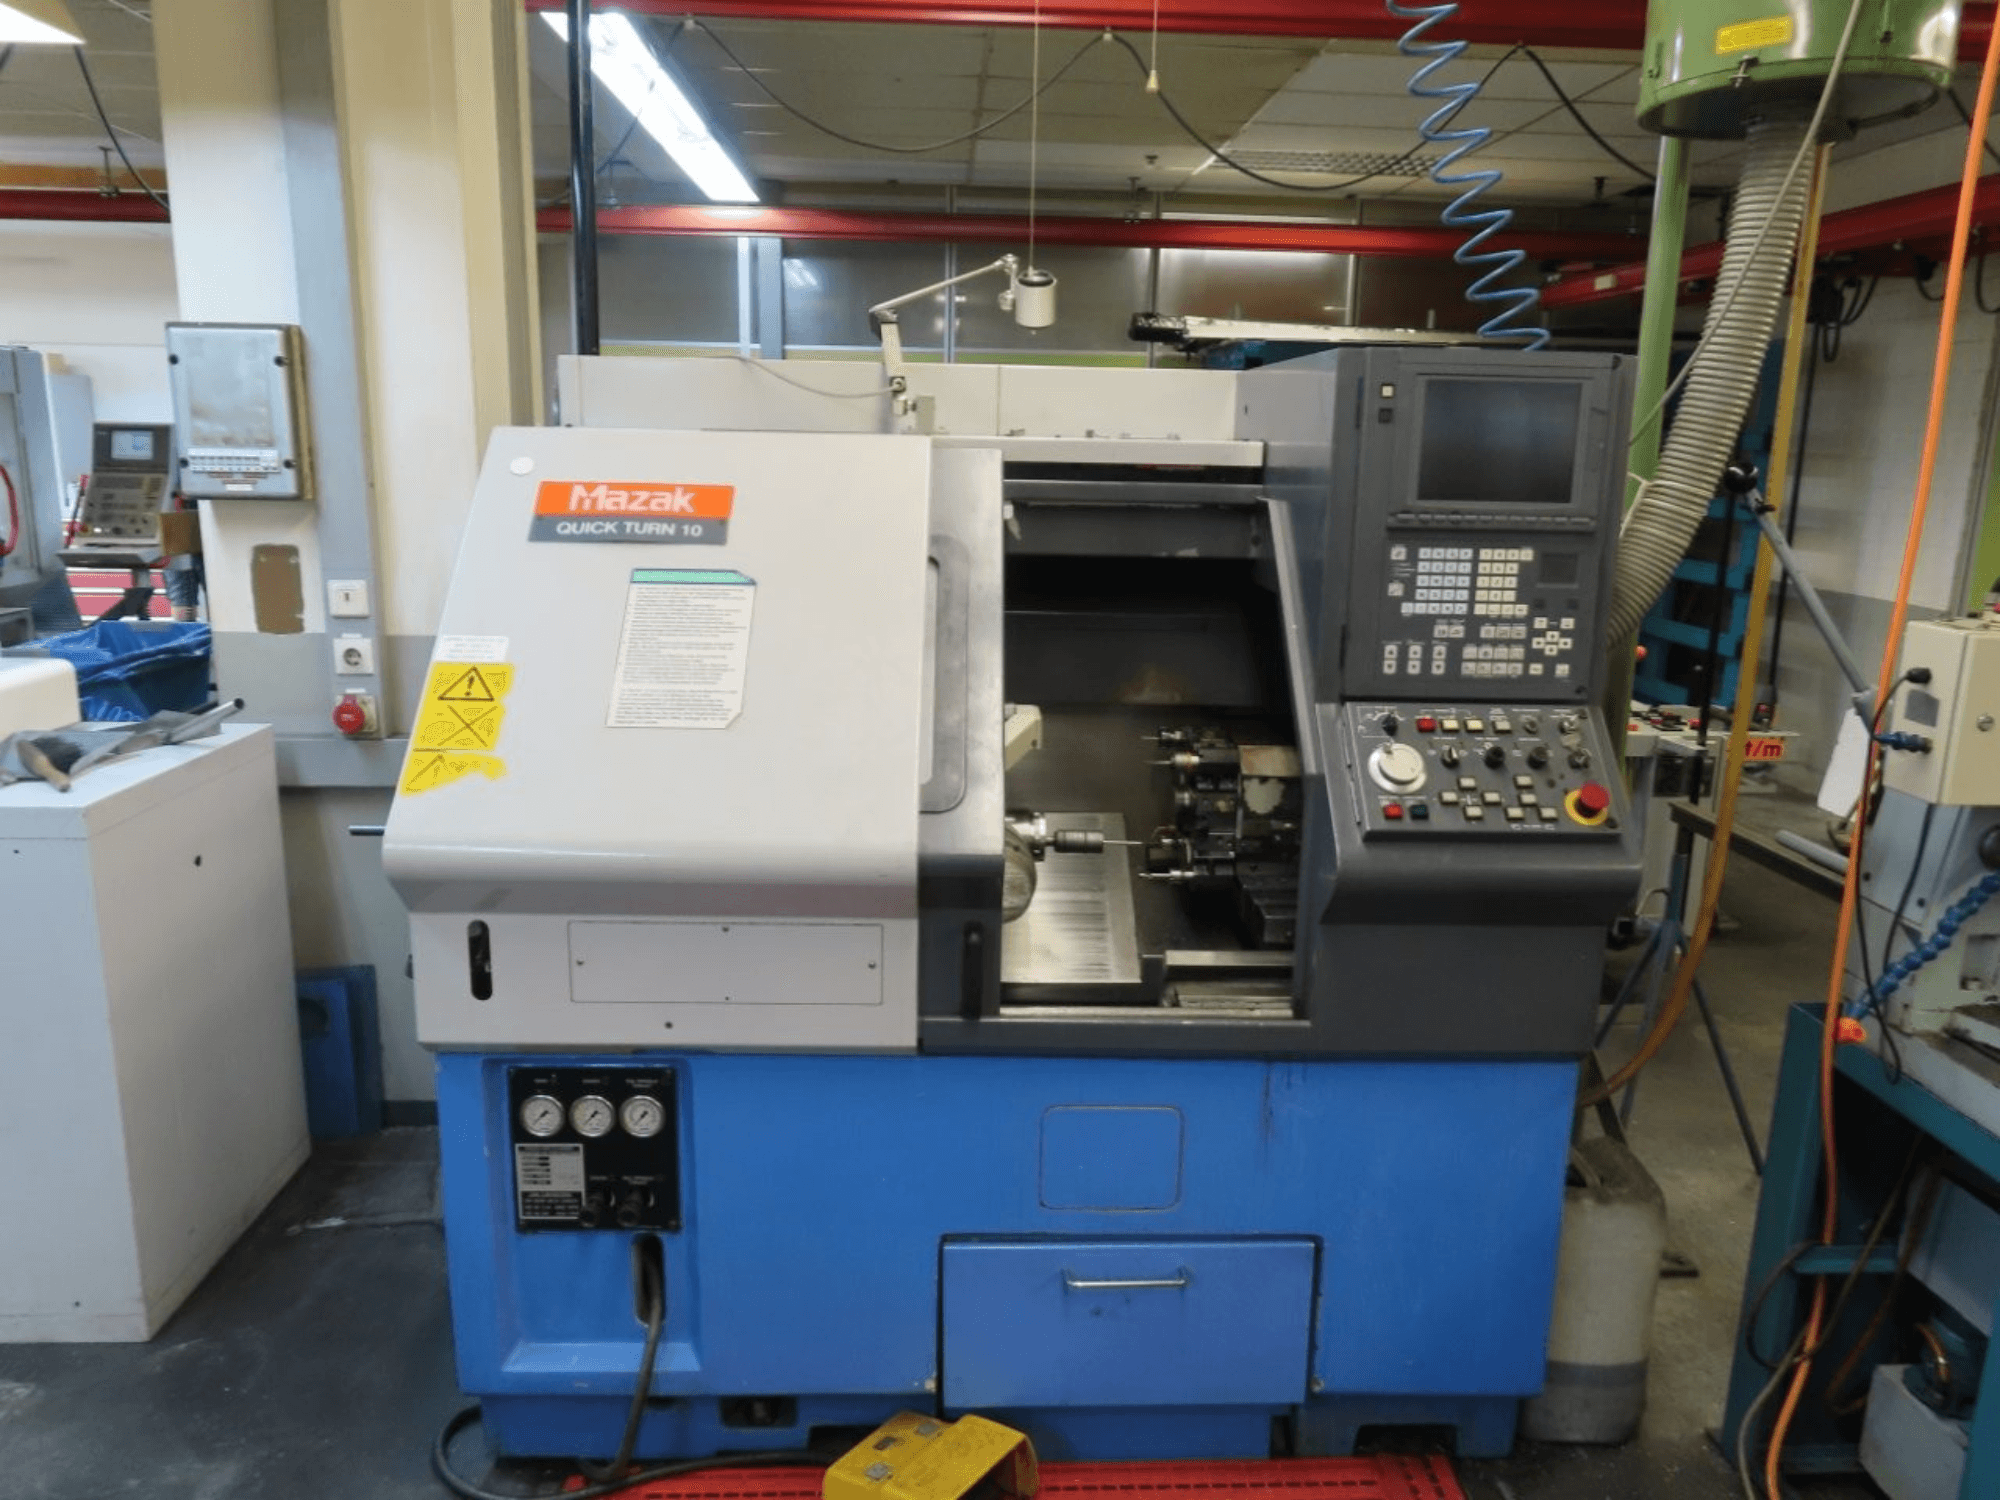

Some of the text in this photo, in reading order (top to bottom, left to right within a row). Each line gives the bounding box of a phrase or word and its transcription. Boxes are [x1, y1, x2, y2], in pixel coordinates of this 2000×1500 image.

[568, 483, 695, 513] Mazak
[556, 521, 703, 537] QUICK TURN 10
